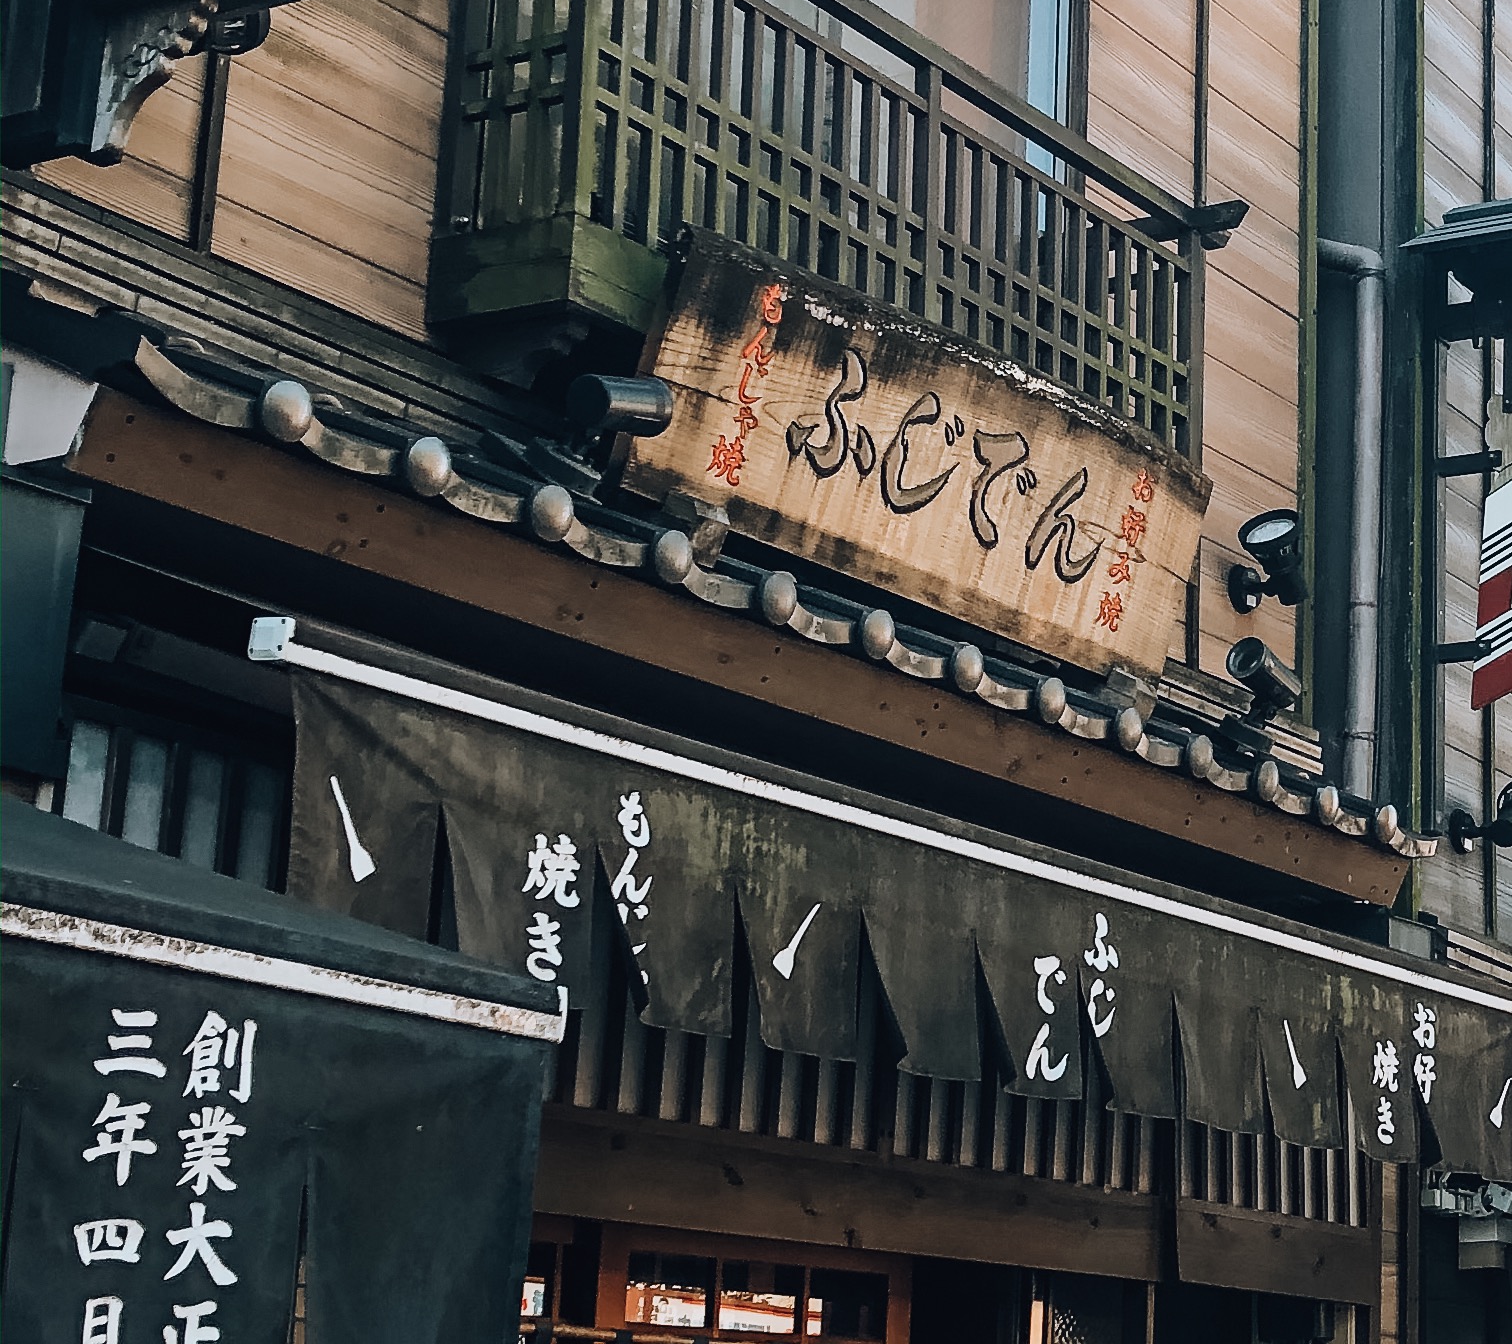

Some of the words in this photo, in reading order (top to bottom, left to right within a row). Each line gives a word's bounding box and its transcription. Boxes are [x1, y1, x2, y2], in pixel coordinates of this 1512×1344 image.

[785, 347, 1104, 583] ふじでん
[1095, 467, 1156, 633] お好み焼
[521, 833, 580, 982] 焼き
[1083, 911, 1119, 1038] ふじ
[1025, 956, 1069, 1083] でん
[1371, 1042, 1399, 1145] 焼き
